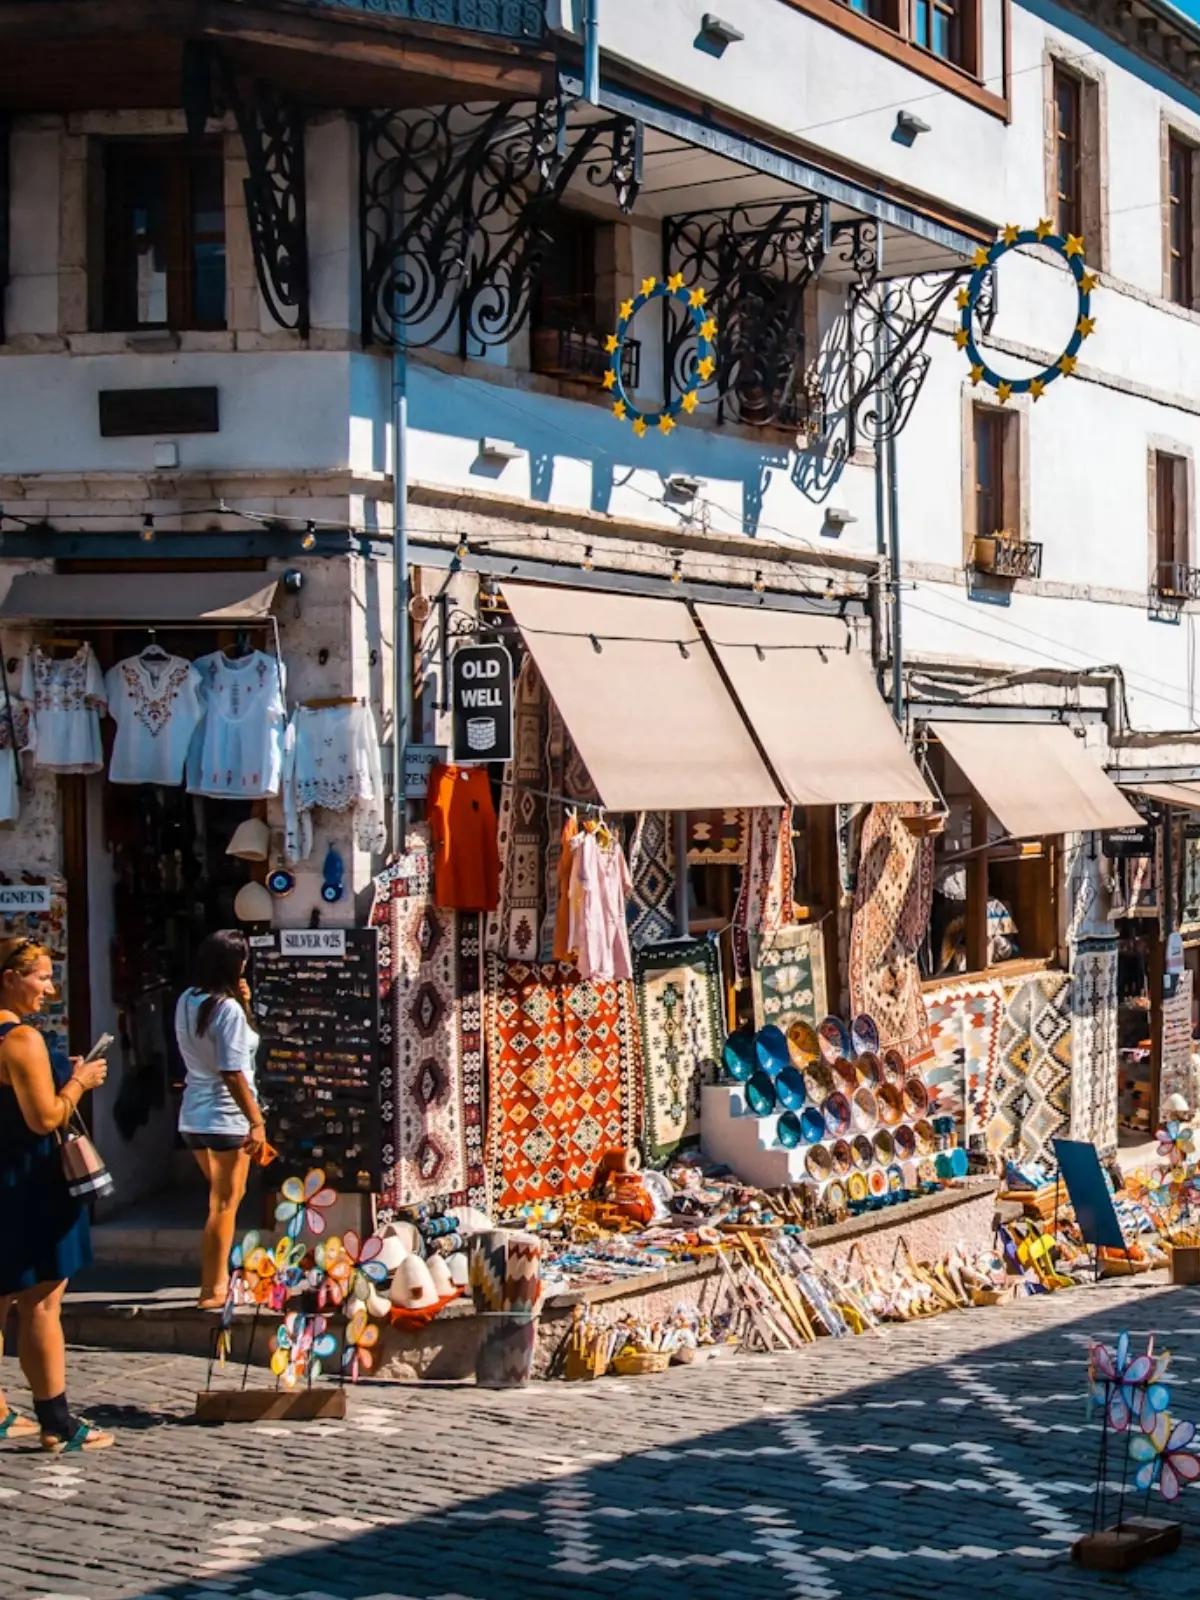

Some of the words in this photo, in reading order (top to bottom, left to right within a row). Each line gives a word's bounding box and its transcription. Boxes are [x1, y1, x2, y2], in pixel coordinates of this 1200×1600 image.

[461, 659, 501, 680] OLD
[460, 687, 502, 708] WELL
[0, 890, 45, 905] GNETS
[285, 933, 322, 949] SILVER
[322, 933, 342, 948] 925
